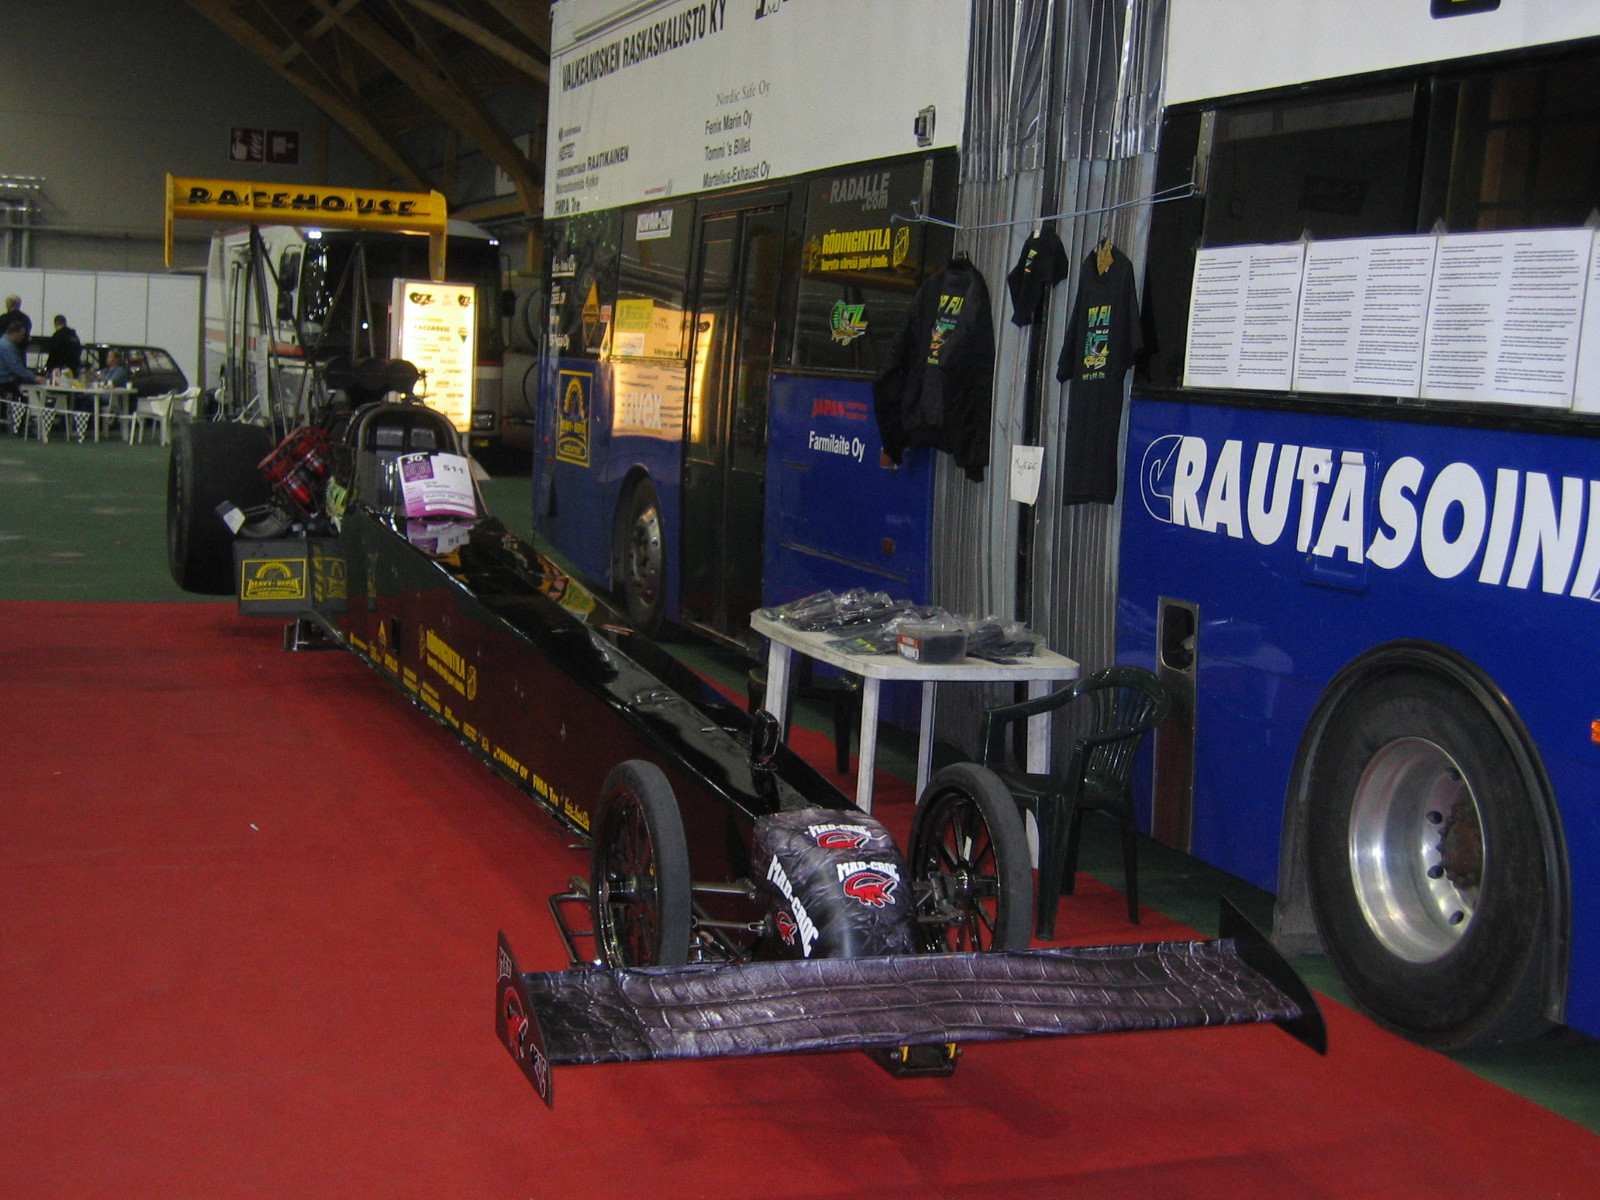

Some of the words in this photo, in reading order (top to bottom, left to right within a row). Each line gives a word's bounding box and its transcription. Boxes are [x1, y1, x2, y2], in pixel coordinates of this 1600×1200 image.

[562, 41, 621, 92] VALKEAKOSKEN
[622, 3, 706, 69] RASKASKALUSTO
[708, 0, 727, 34] KY
[758, 80, 770, 98] Oy
[742, 109, 752, 130] Oy
[759, 160, 771, 180] Oy
[829, 171, 890, 204] RADALLE
[188, 186, 416, 217] RACEHOUSE
[808, 430, 850, 456] Farmilaite
[851, 437, 866, 463] Oy
[807, 824, 873, 838] MAD-CROC
[836, 860, 901, 883] MAD-CROC
[766, 853, 820, 958] MAD-CROC
